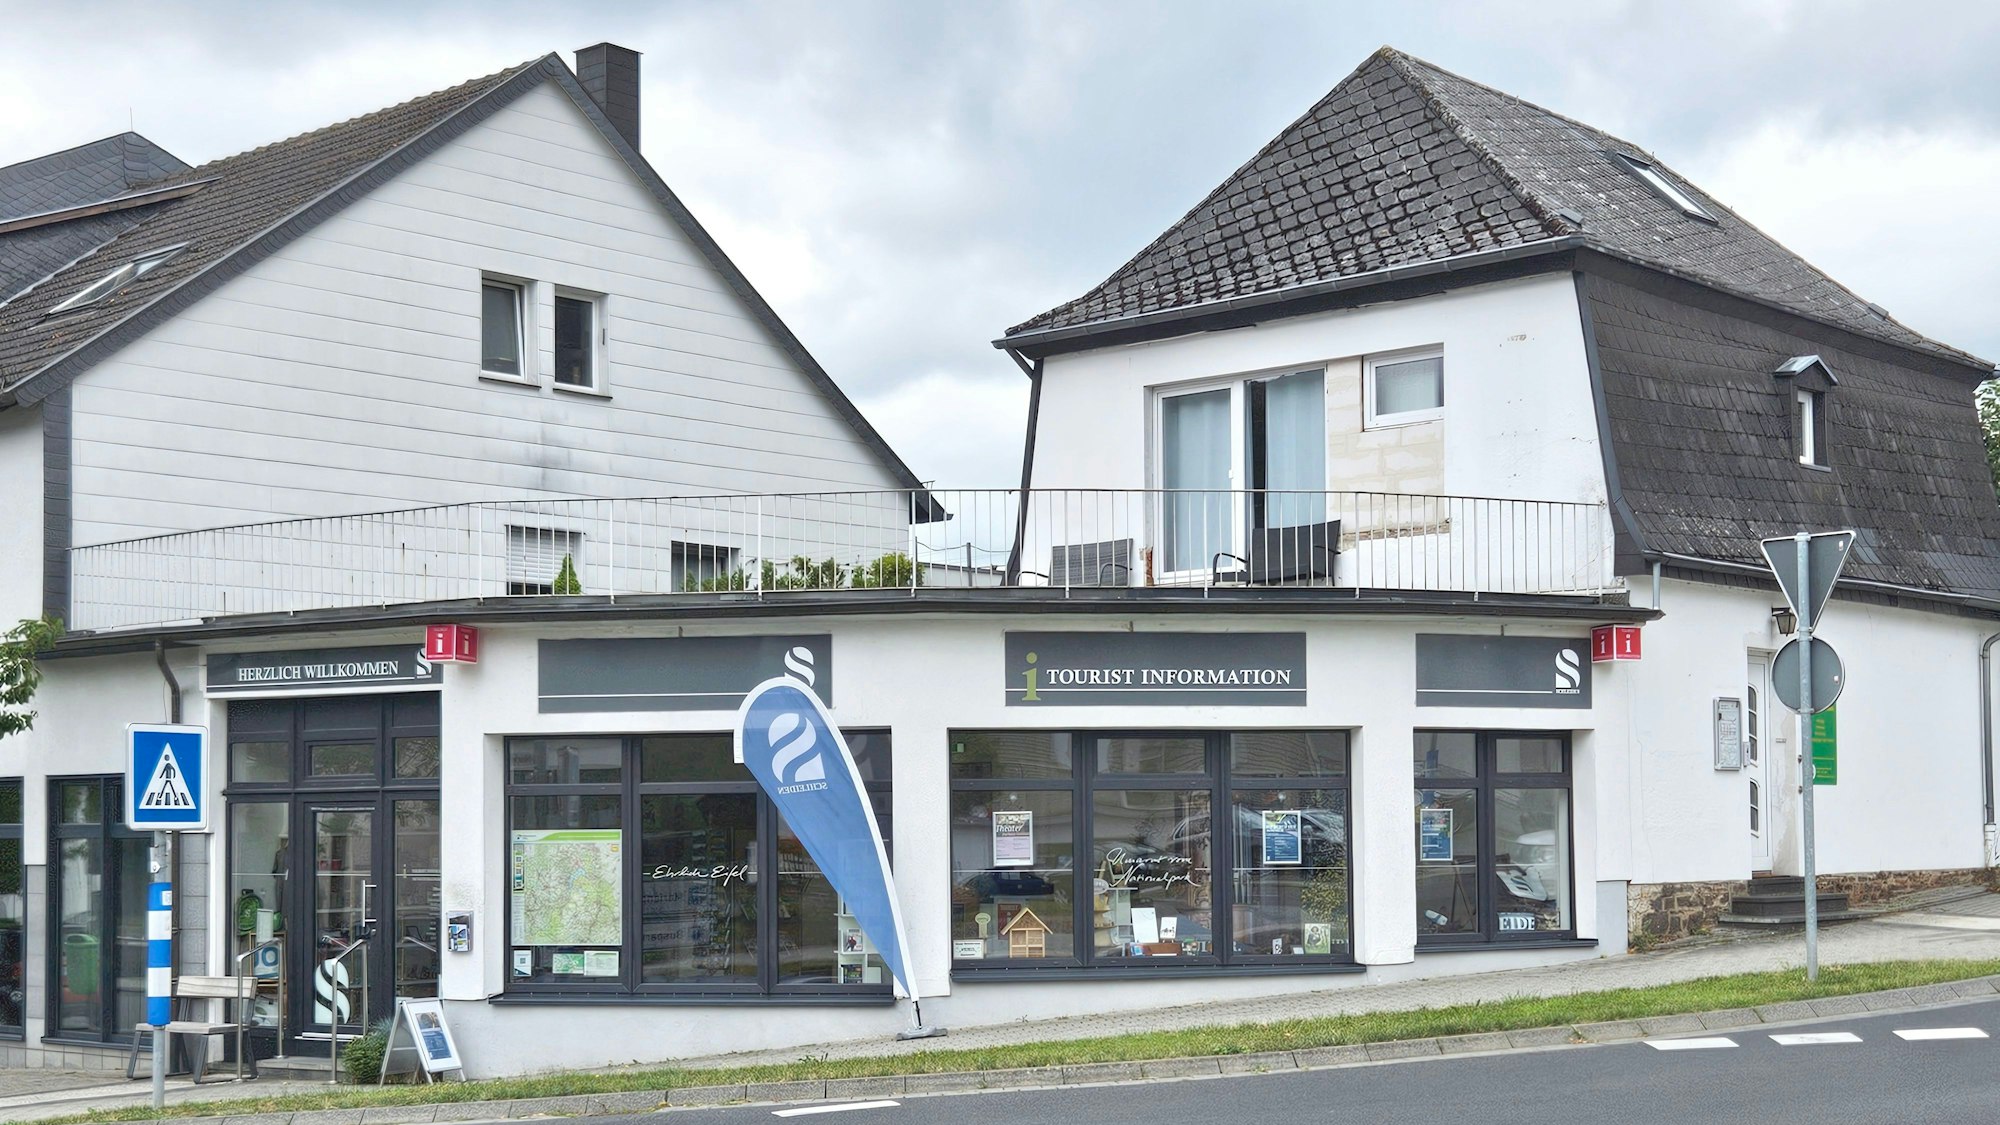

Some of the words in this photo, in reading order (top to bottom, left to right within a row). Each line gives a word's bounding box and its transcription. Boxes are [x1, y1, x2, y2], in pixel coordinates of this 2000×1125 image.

[238, 665, 301, 681] HERZLICH
[304, 661, 399, 679] WILLKOMMEN
[1021, 652, 1041, 700] i
[1047, 669, 1135, 685] TOURIST
[1141, 669, 1291, 685] INFORMATION
[711, 864, 749, 887] Eifel
